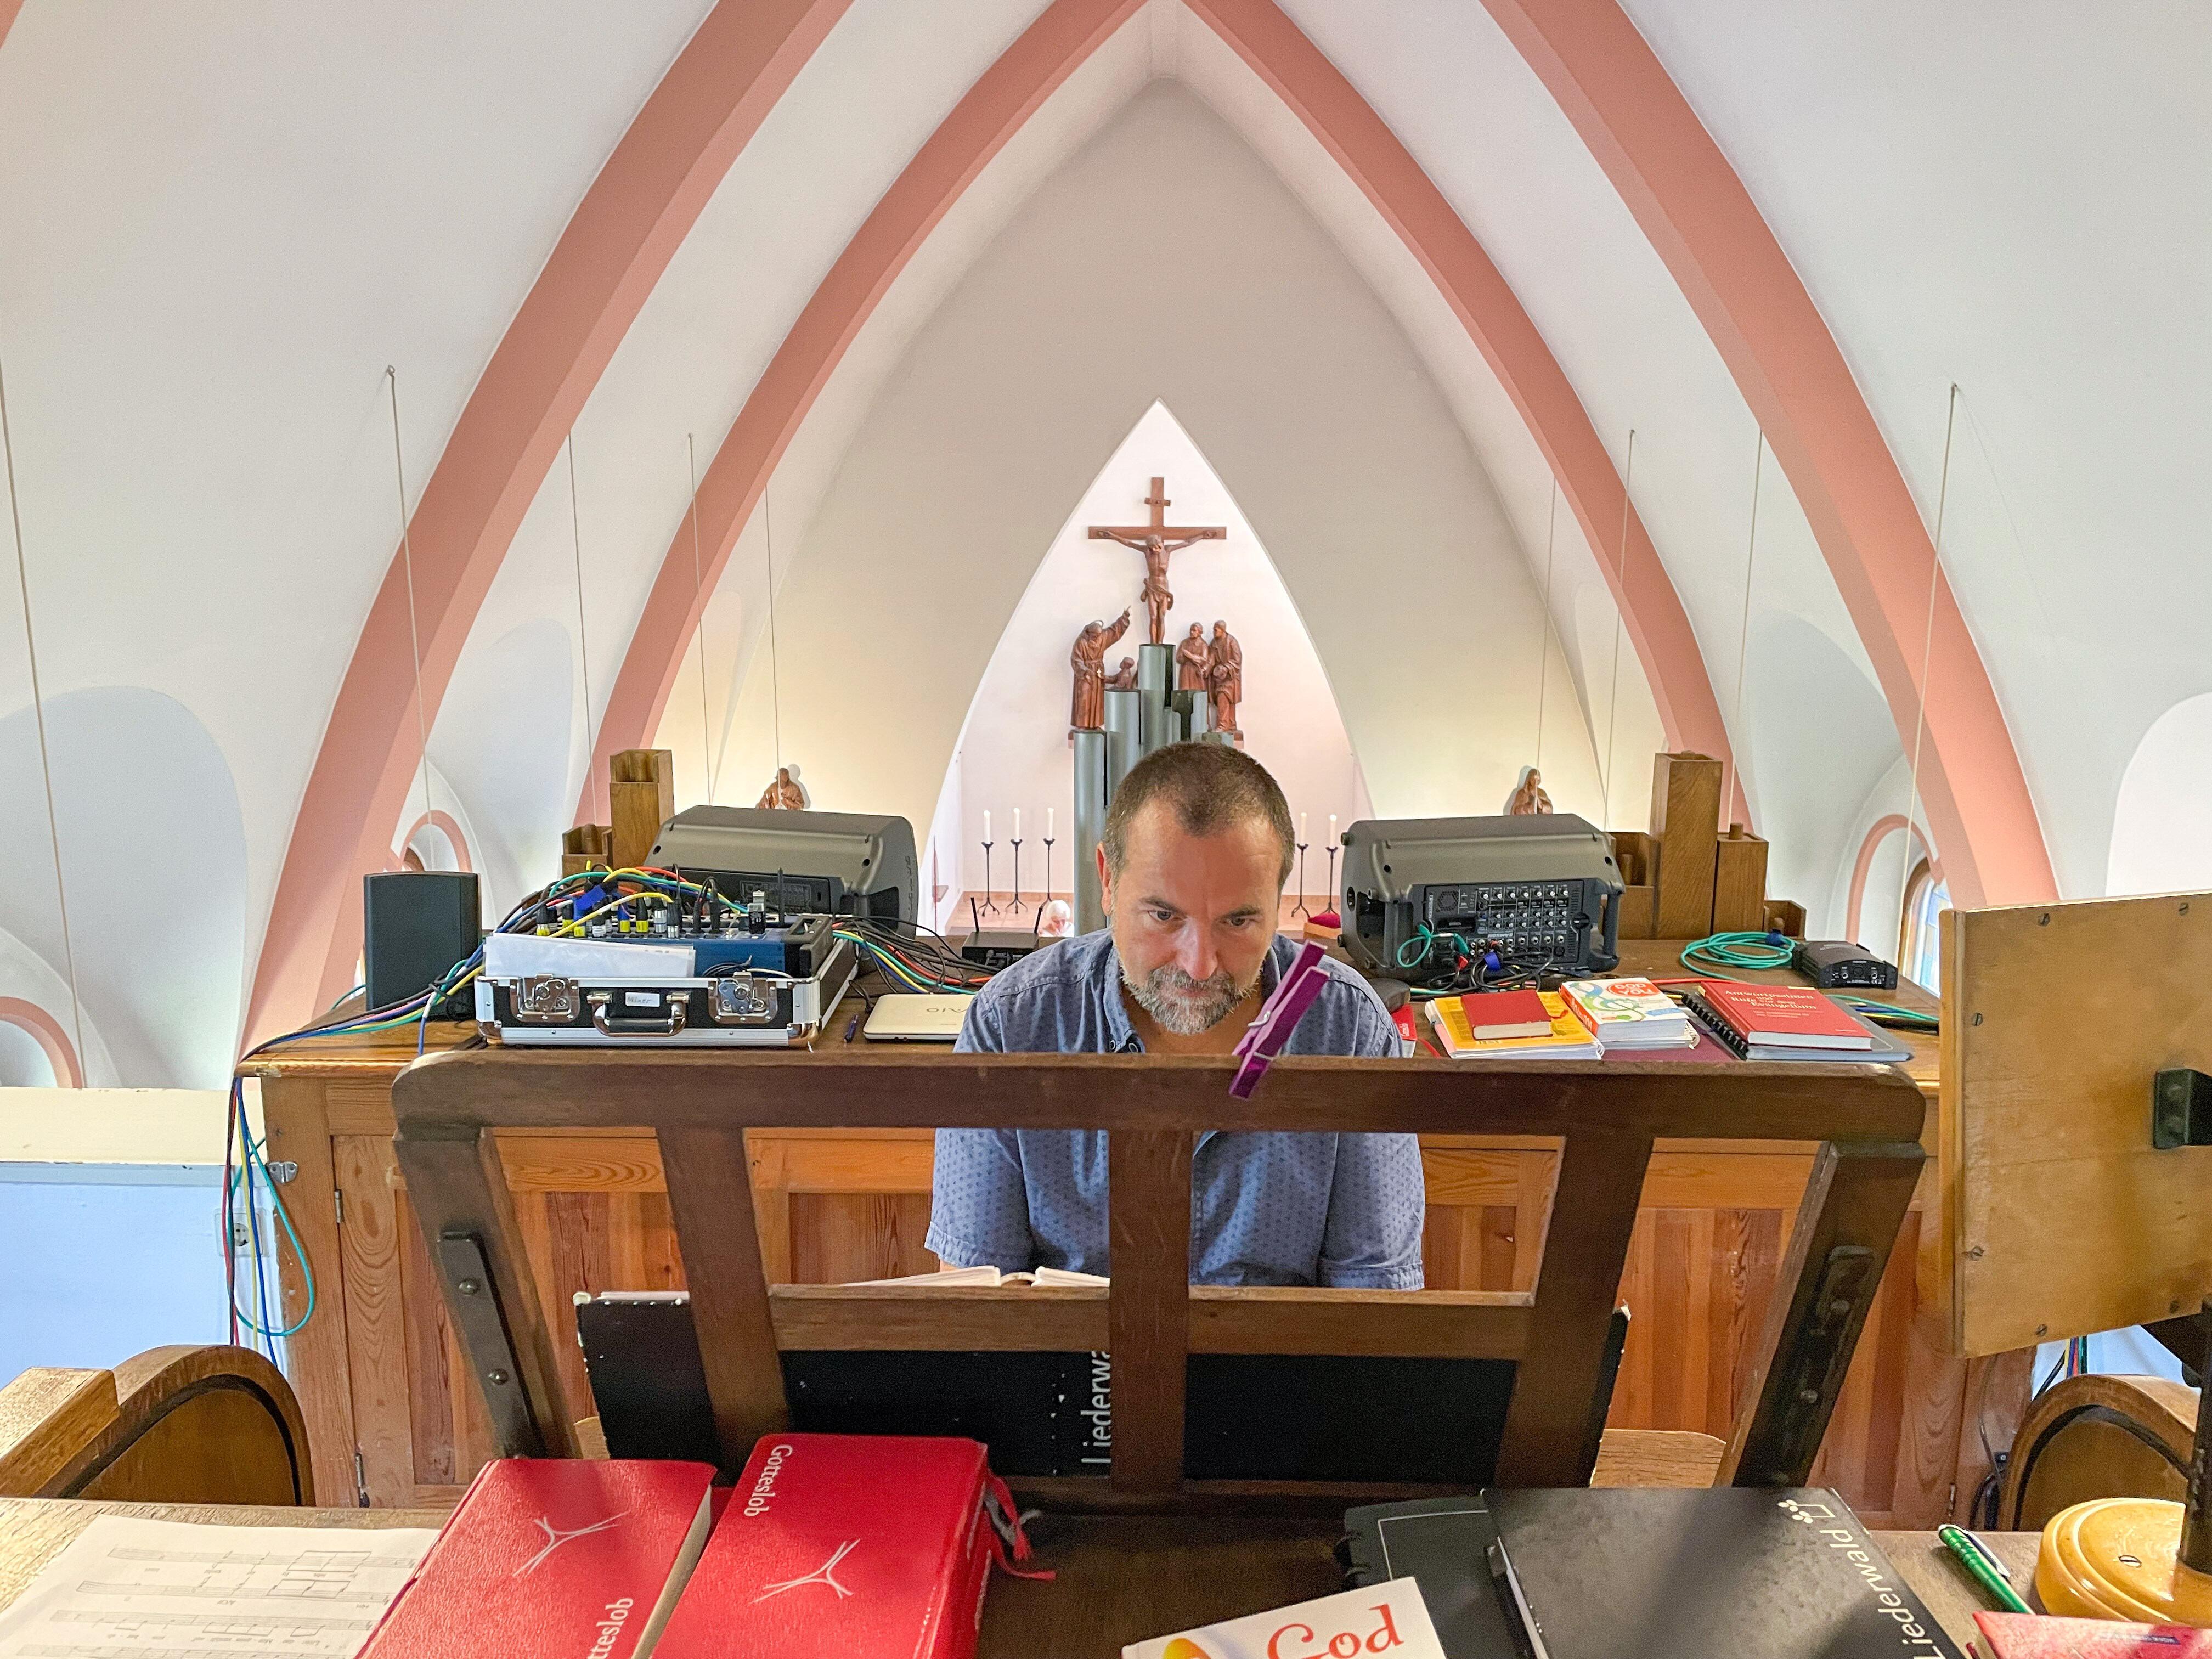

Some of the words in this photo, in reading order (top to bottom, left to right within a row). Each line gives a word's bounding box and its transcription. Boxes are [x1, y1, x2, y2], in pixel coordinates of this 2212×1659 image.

[743, 1444, 793, 1517] Gotteslob
[1267, 1603, 1404, 1659] God
[1819, 1530, 1946, 1659] Liederwald
